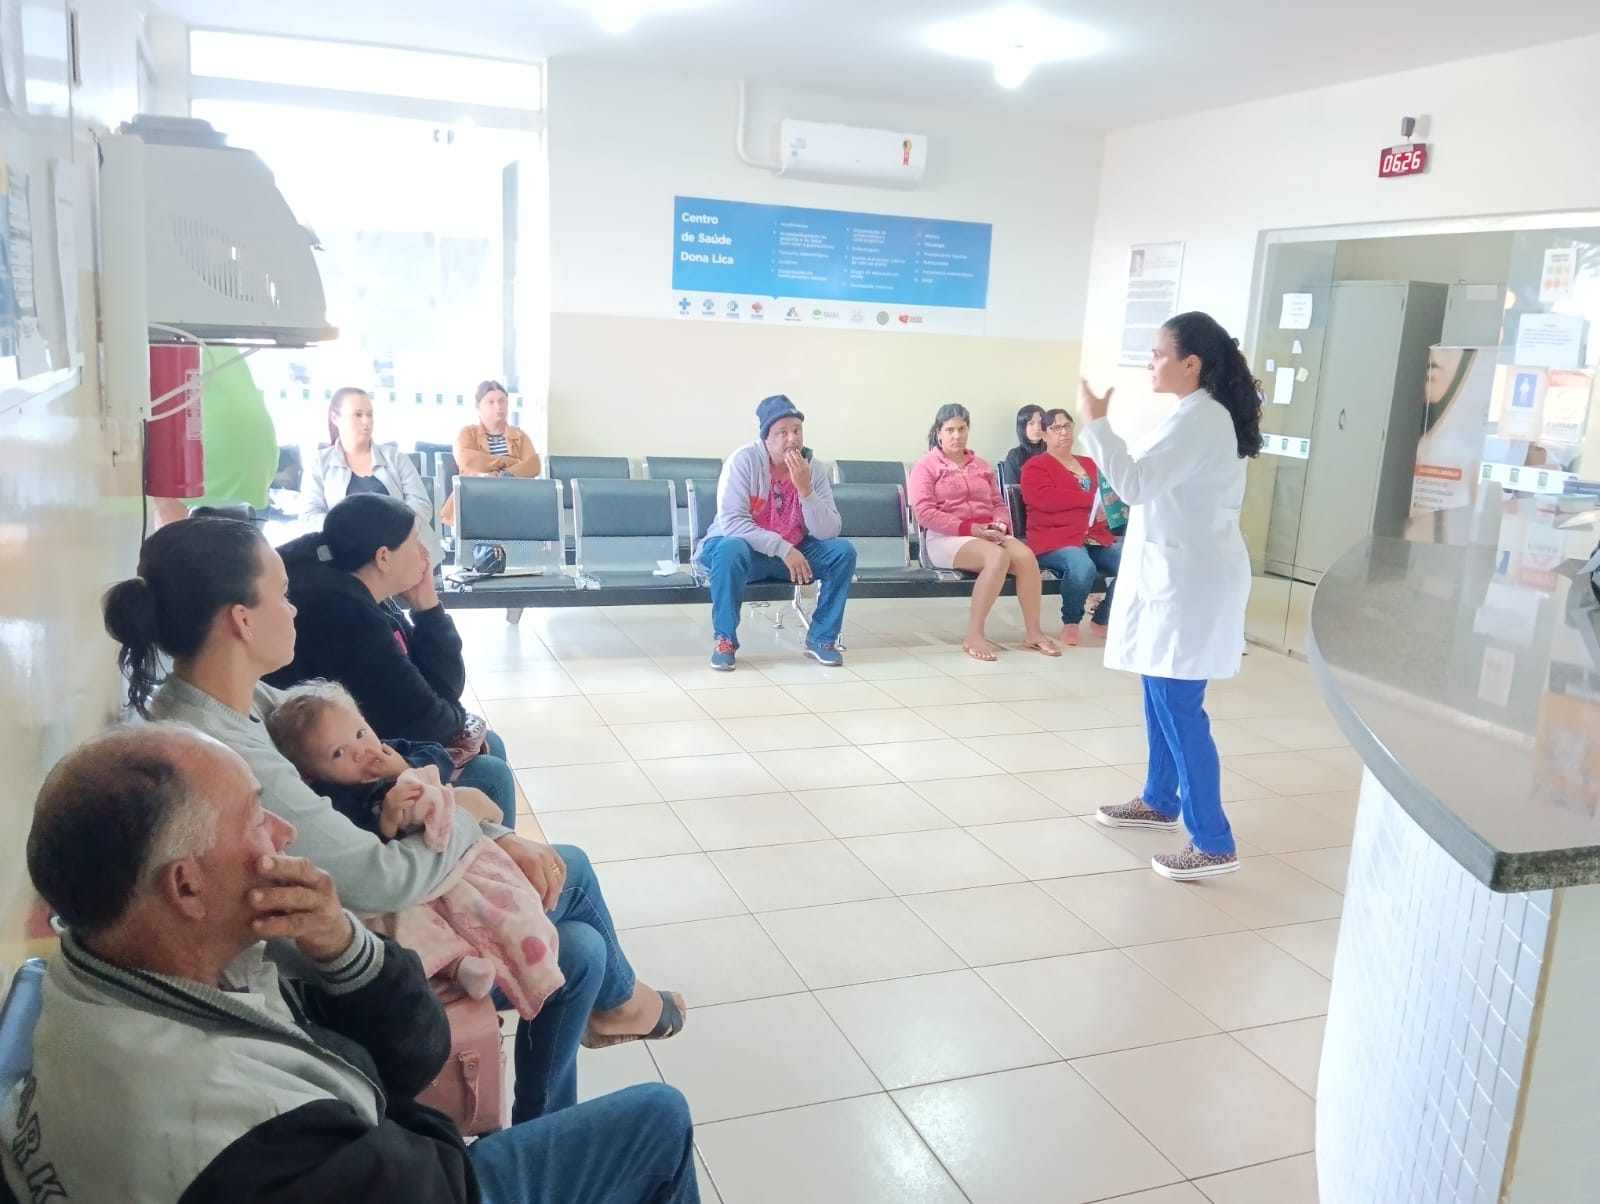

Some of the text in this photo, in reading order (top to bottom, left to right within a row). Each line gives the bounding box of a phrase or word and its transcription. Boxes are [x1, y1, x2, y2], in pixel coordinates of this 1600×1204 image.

[682, 212, 719, 224] Centro
[681, 232, 732, 246] de Saúde
[680, 252, 734, 265] Dona Lica
